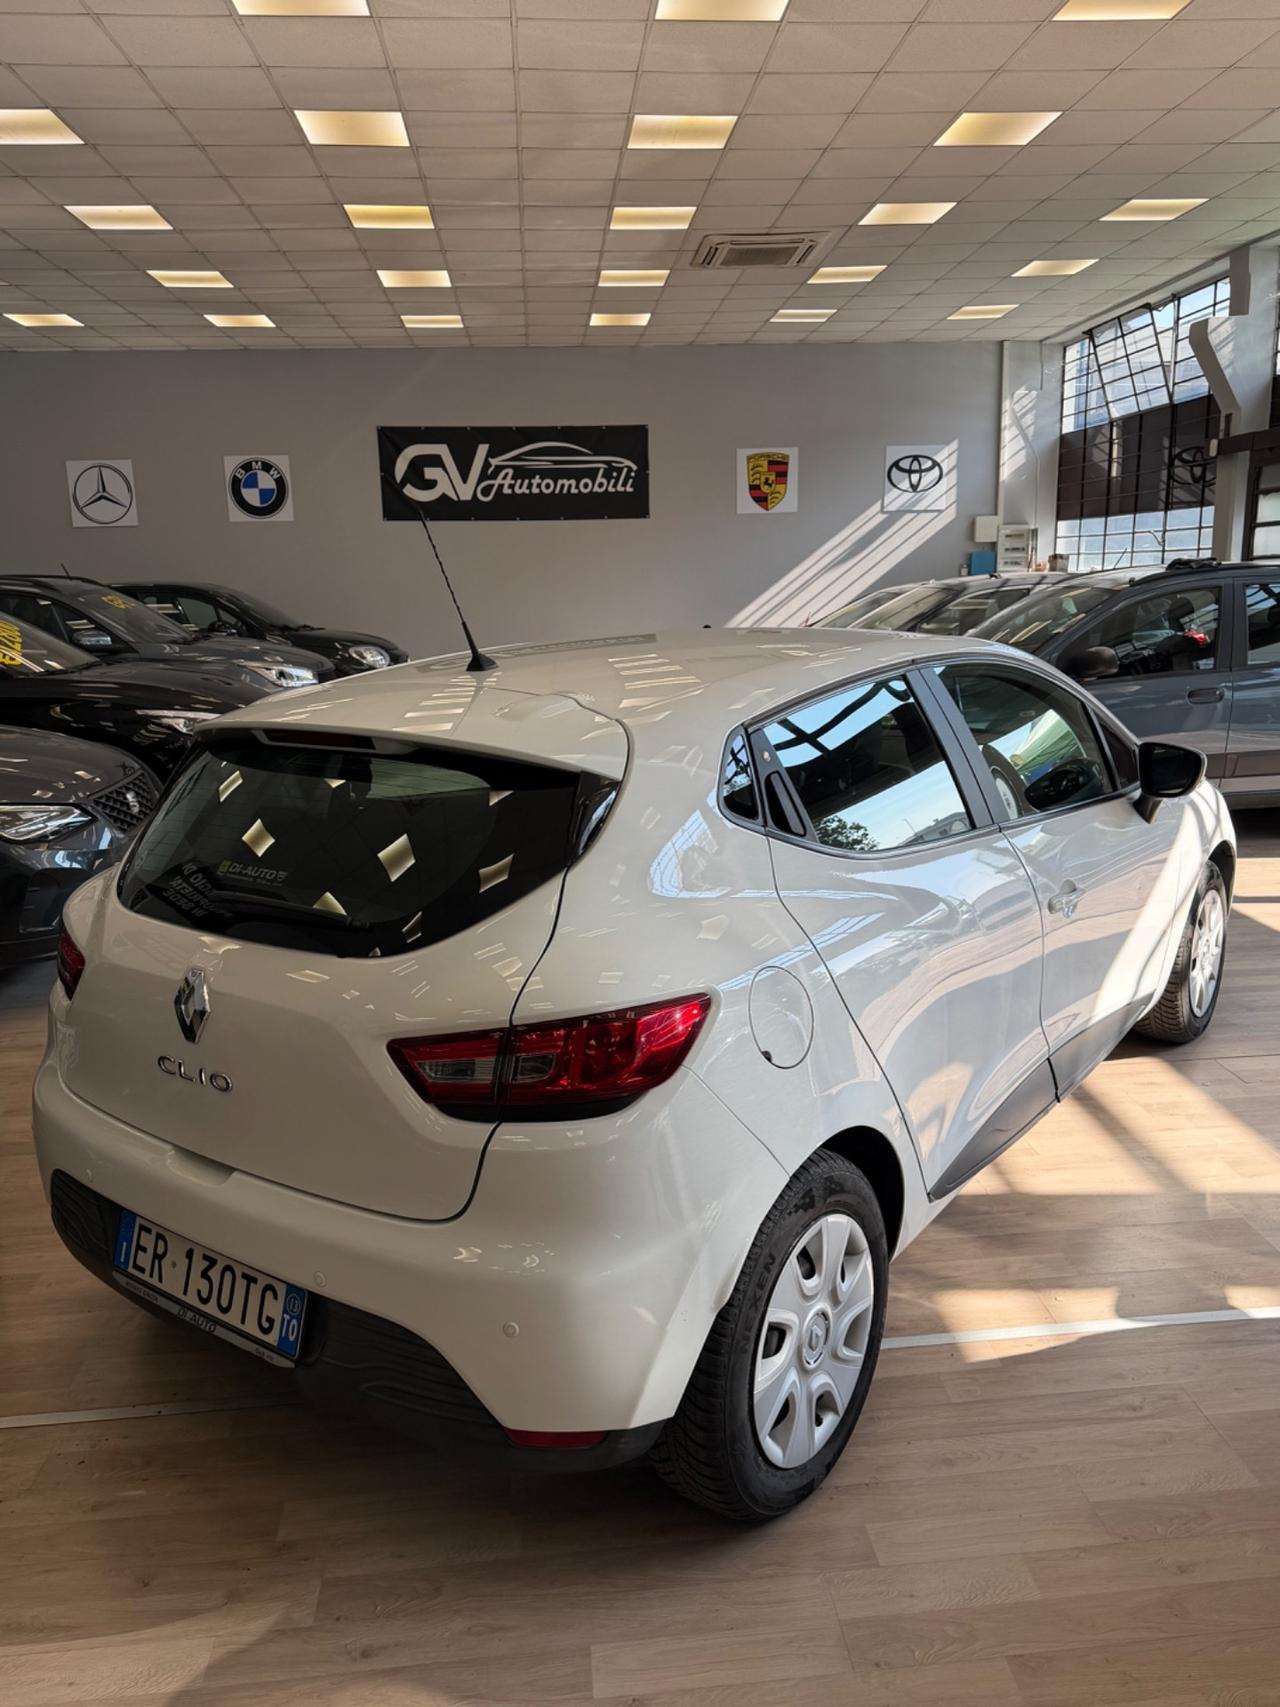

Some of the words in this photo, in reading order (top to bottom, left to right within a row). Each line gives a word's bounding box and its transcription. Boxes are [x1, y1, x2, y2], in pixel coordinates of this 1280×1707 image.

[234, 461, 281, 480] BMW
[394, 443, 490, 502] GV
[476, 466, 636, 502] Automobili
[158, 1056, 233, 1092] CLIO
[132, 1223, 168, 1284] ER
[182, 1247, 279, 1336] 130TG
[281, 1313, 298, 1342] TO
